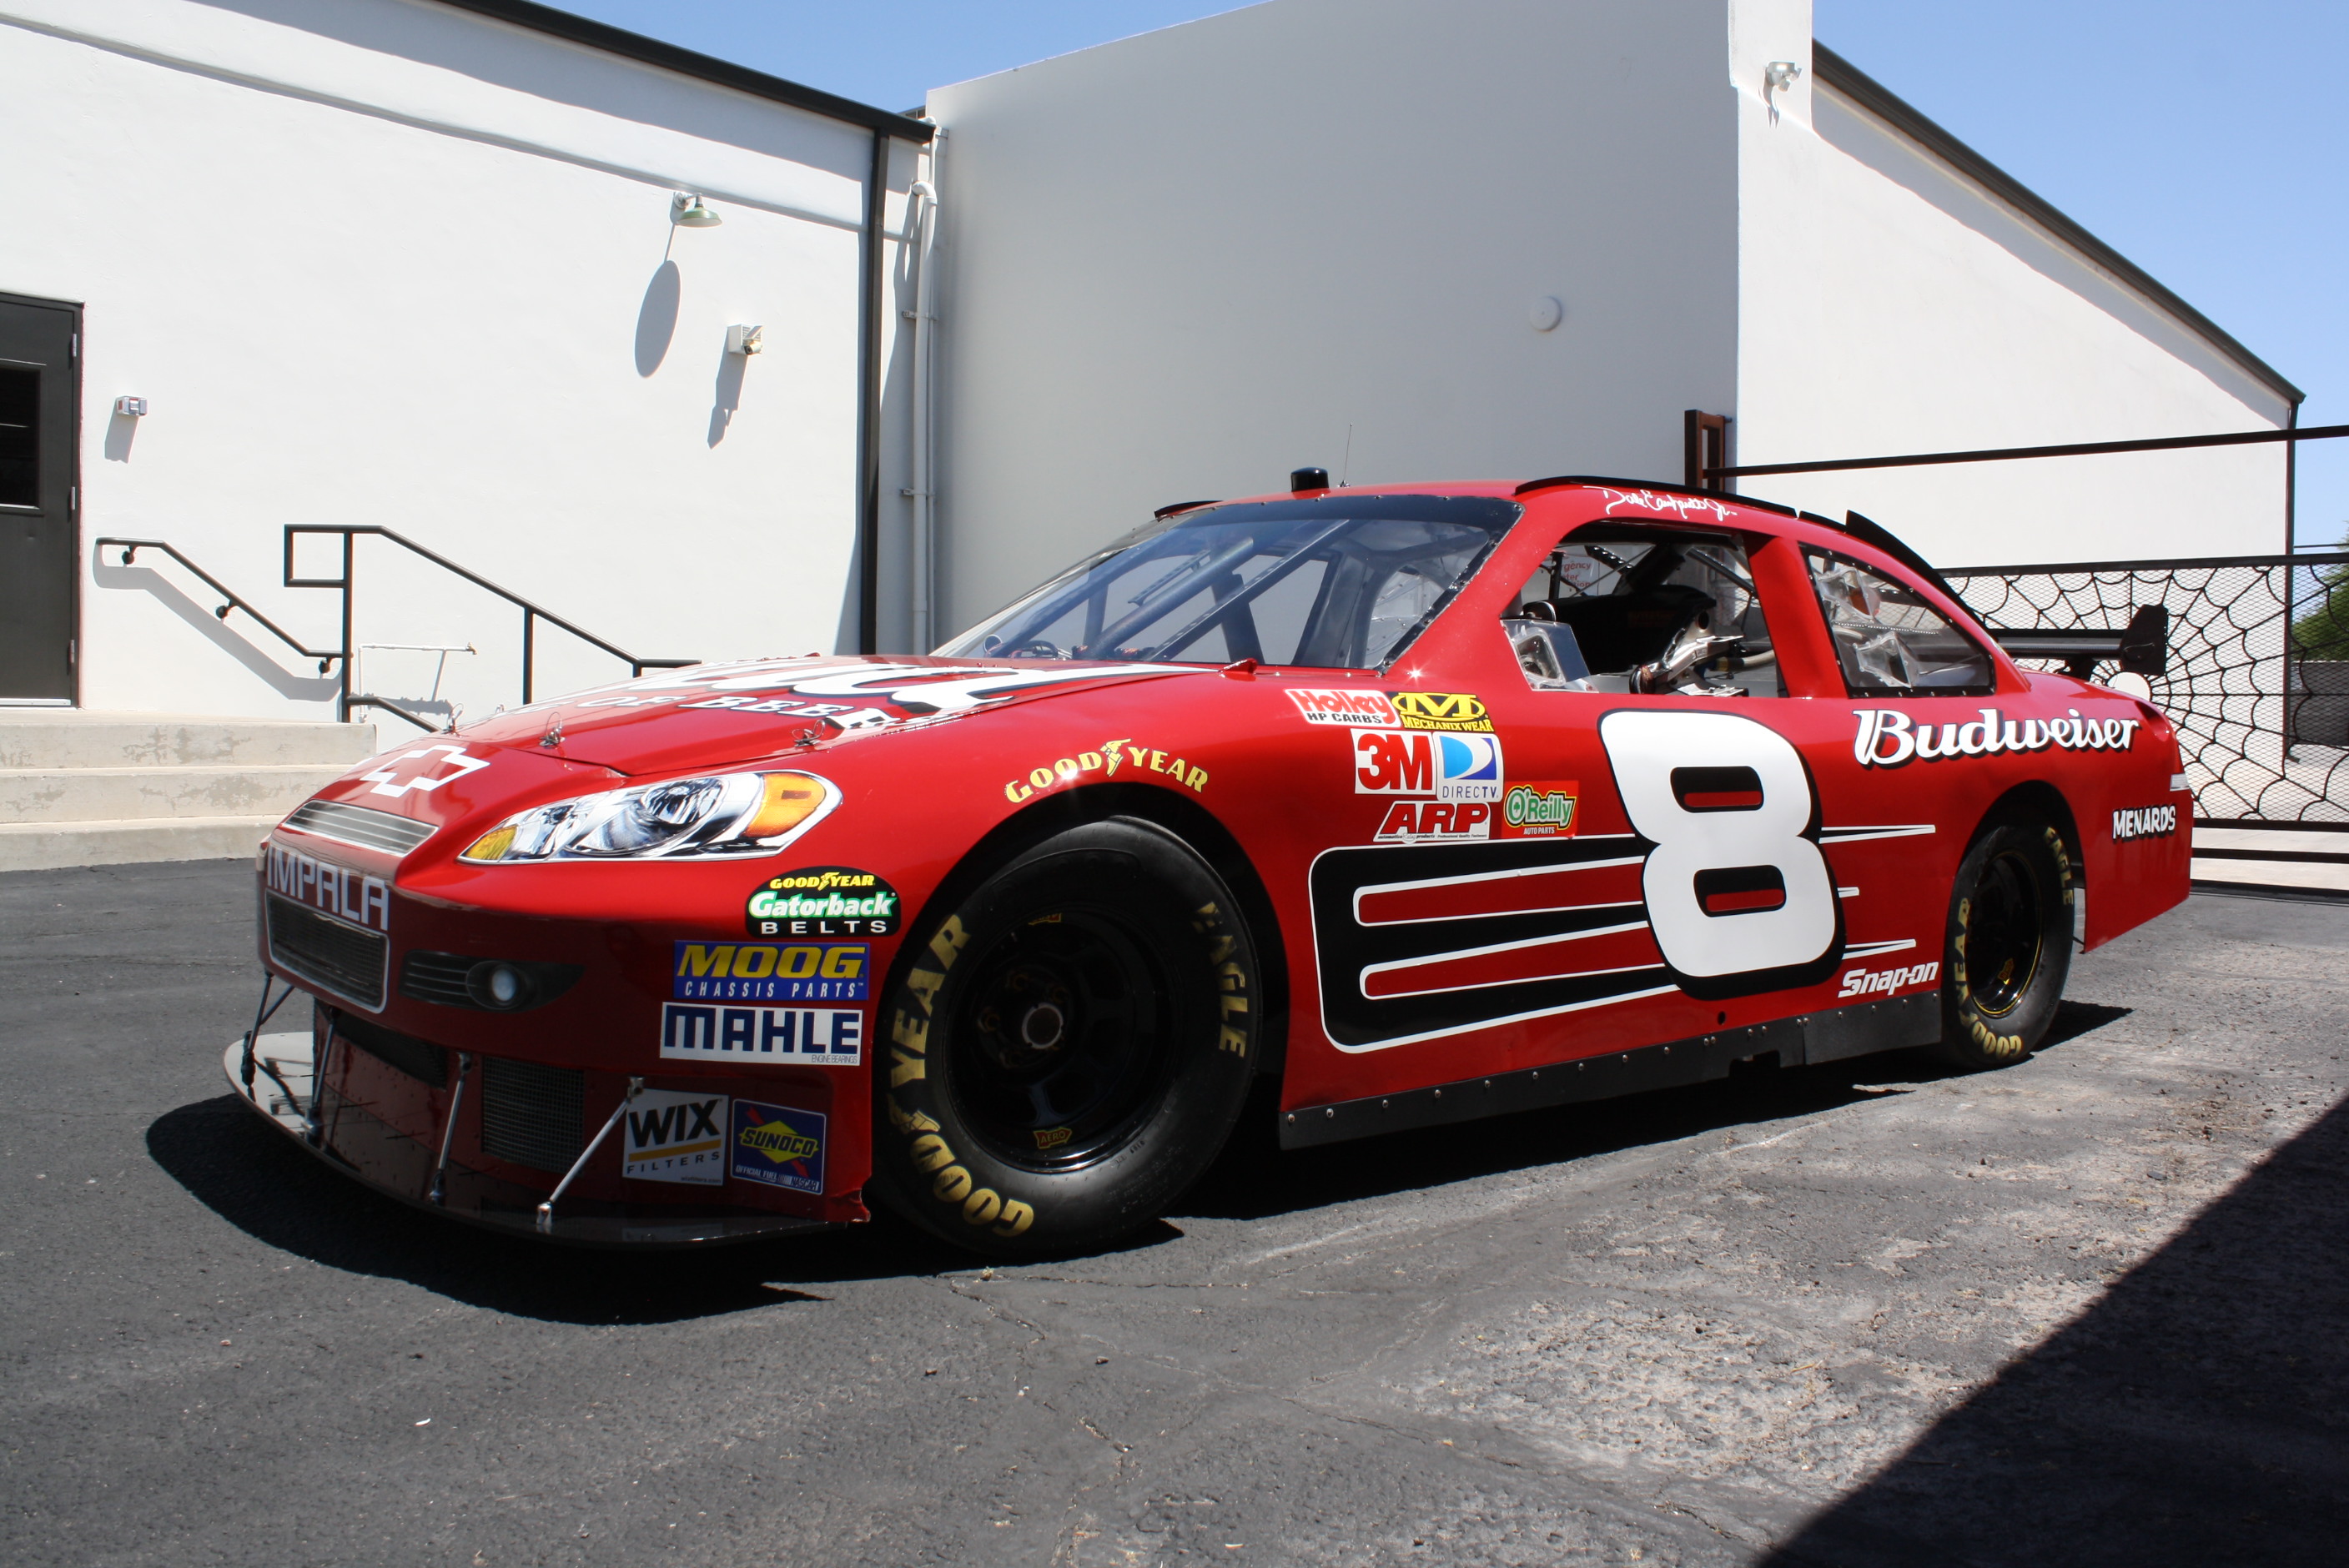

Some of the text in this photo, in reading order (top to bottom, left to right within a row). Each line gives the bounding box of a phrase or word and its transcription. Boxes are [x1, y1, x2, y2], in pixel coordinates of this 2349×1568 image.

[1293, 690, 1396, 724] Holley
[1307, 712, 1382, 724] HP CARBS
[1402, 716, 1494, 732] MECHANIX WEAR
[1852, 707, 2142, 766] Budweiser
[1357, 733, 1431, 790] 3M
[1441, 786, 1496, 799] DIRECTV
[1505, 787, 1573, 827] O'Reilly
[1379, 803, 1489, 834] ARP
[1538, 826, 1555, 835] PARTS
[2112, 804, 2176, 840] MENARDS
[1597, 709, 1840, 985] 8
[267, 844, 390, 932] IMPALA
[749, 891, 893, 918] Gatorback
[760, 919, 888, 935] BELTS
[677, 944, 866, 979] MOOG
[684, 981, 856, 998] CHASSIS PARTS
[1192, 902, 1247, 1058] EAGLE
[1837, 961, 1939, 999] Snap-on
[663, 1004, 860, 1055] MAHLE
[811, 1054, 858, 1064] ENGINE BEARINGS
[629, 1098, 721, 1148] WIX
[1040, 1129, 1067, 1143] AERO
[741, 1128, 818, 1156] SUNOCO
[626, 1151, 721, 1175] FILTERS
[735, 1164, 762, 1177] OFFICIAL
[762, 1169, 777, 1181] FUEL
